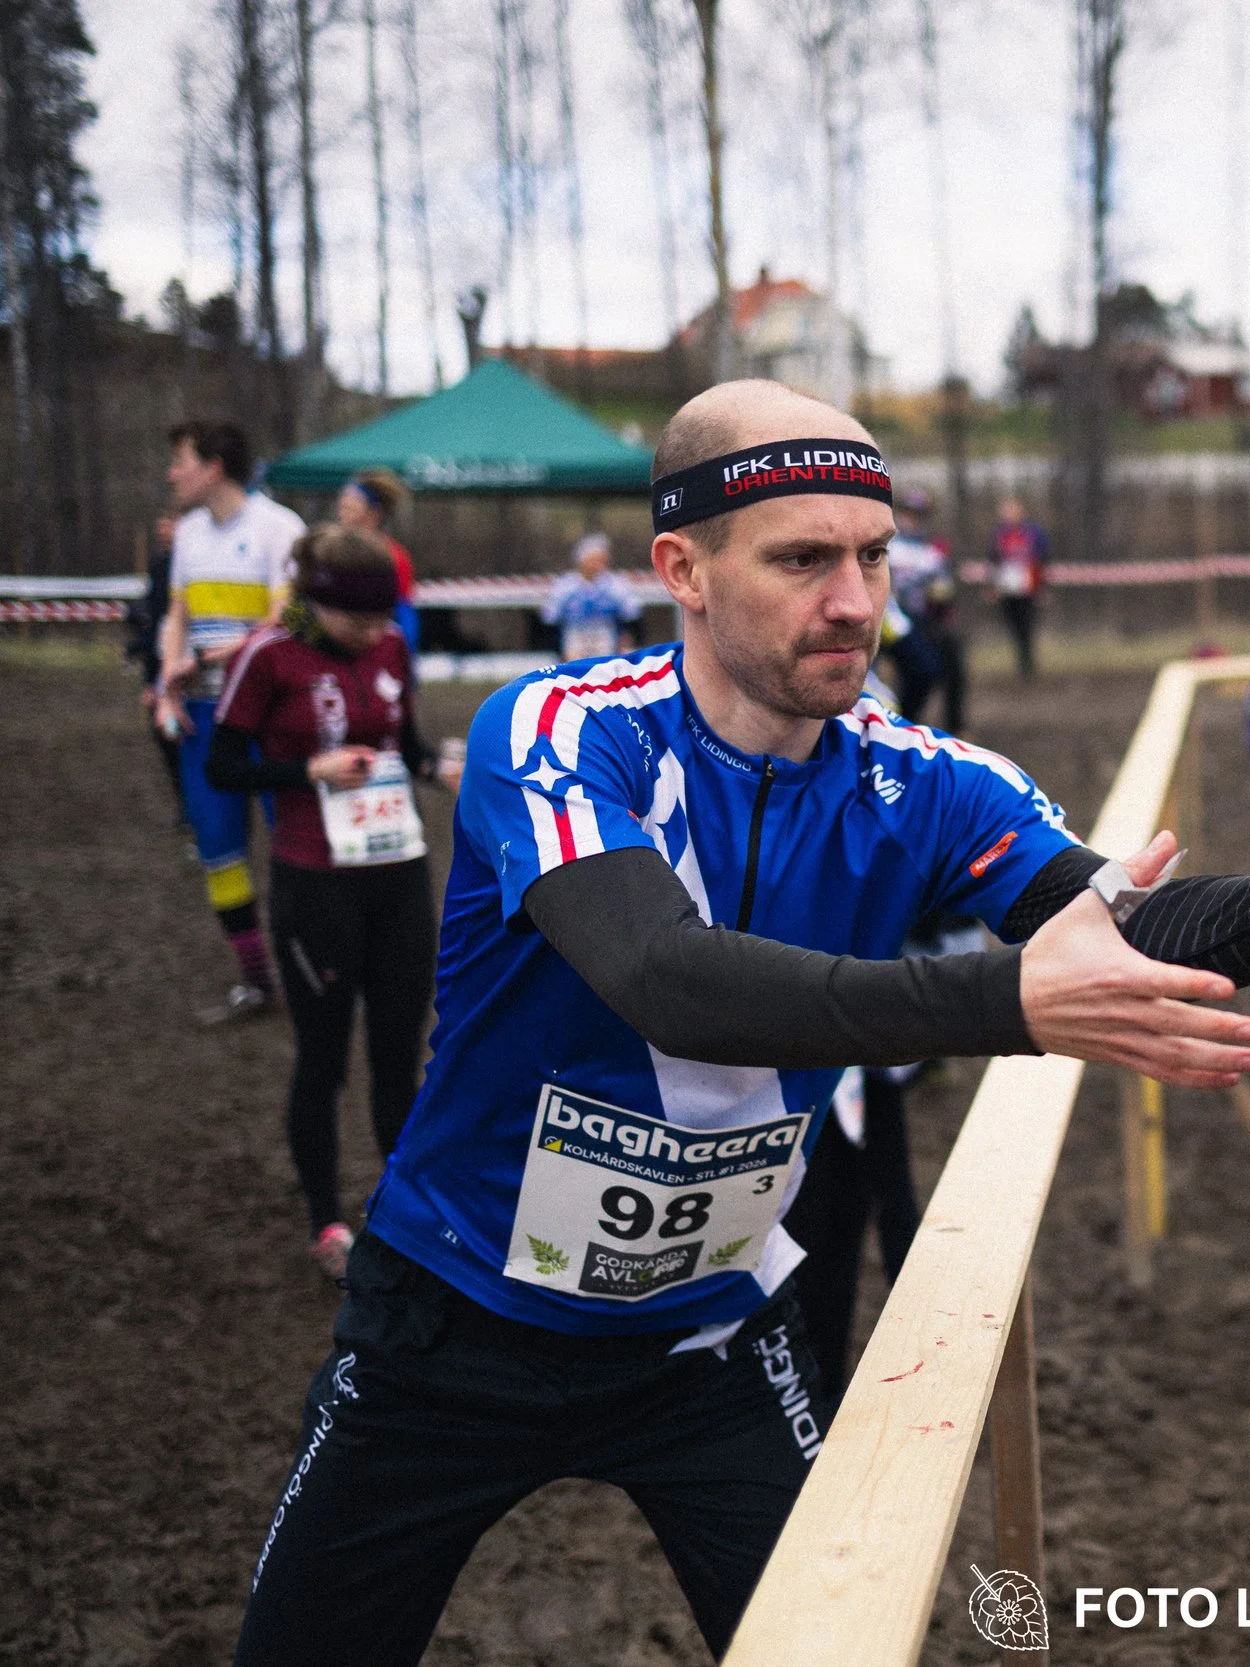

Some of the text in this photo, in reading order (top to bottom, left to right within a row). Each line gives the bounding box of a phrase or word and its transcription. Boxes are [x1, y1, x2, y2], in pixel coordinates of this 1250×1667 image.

[723, 454, 773, 483] IFK
[724, 466, 892, 496] ORIENTERING
[687, 714, 702, 738] IFK
[546, 1094, 800, 1164] bagheera
[563, 1142, 685, 1185] KOLMÅRDSKAVLEN
[696, 1169, 715, 1181] STL
[753, 1175, 774, 1195] 3
[598, 1185, 714, 1241] 98
